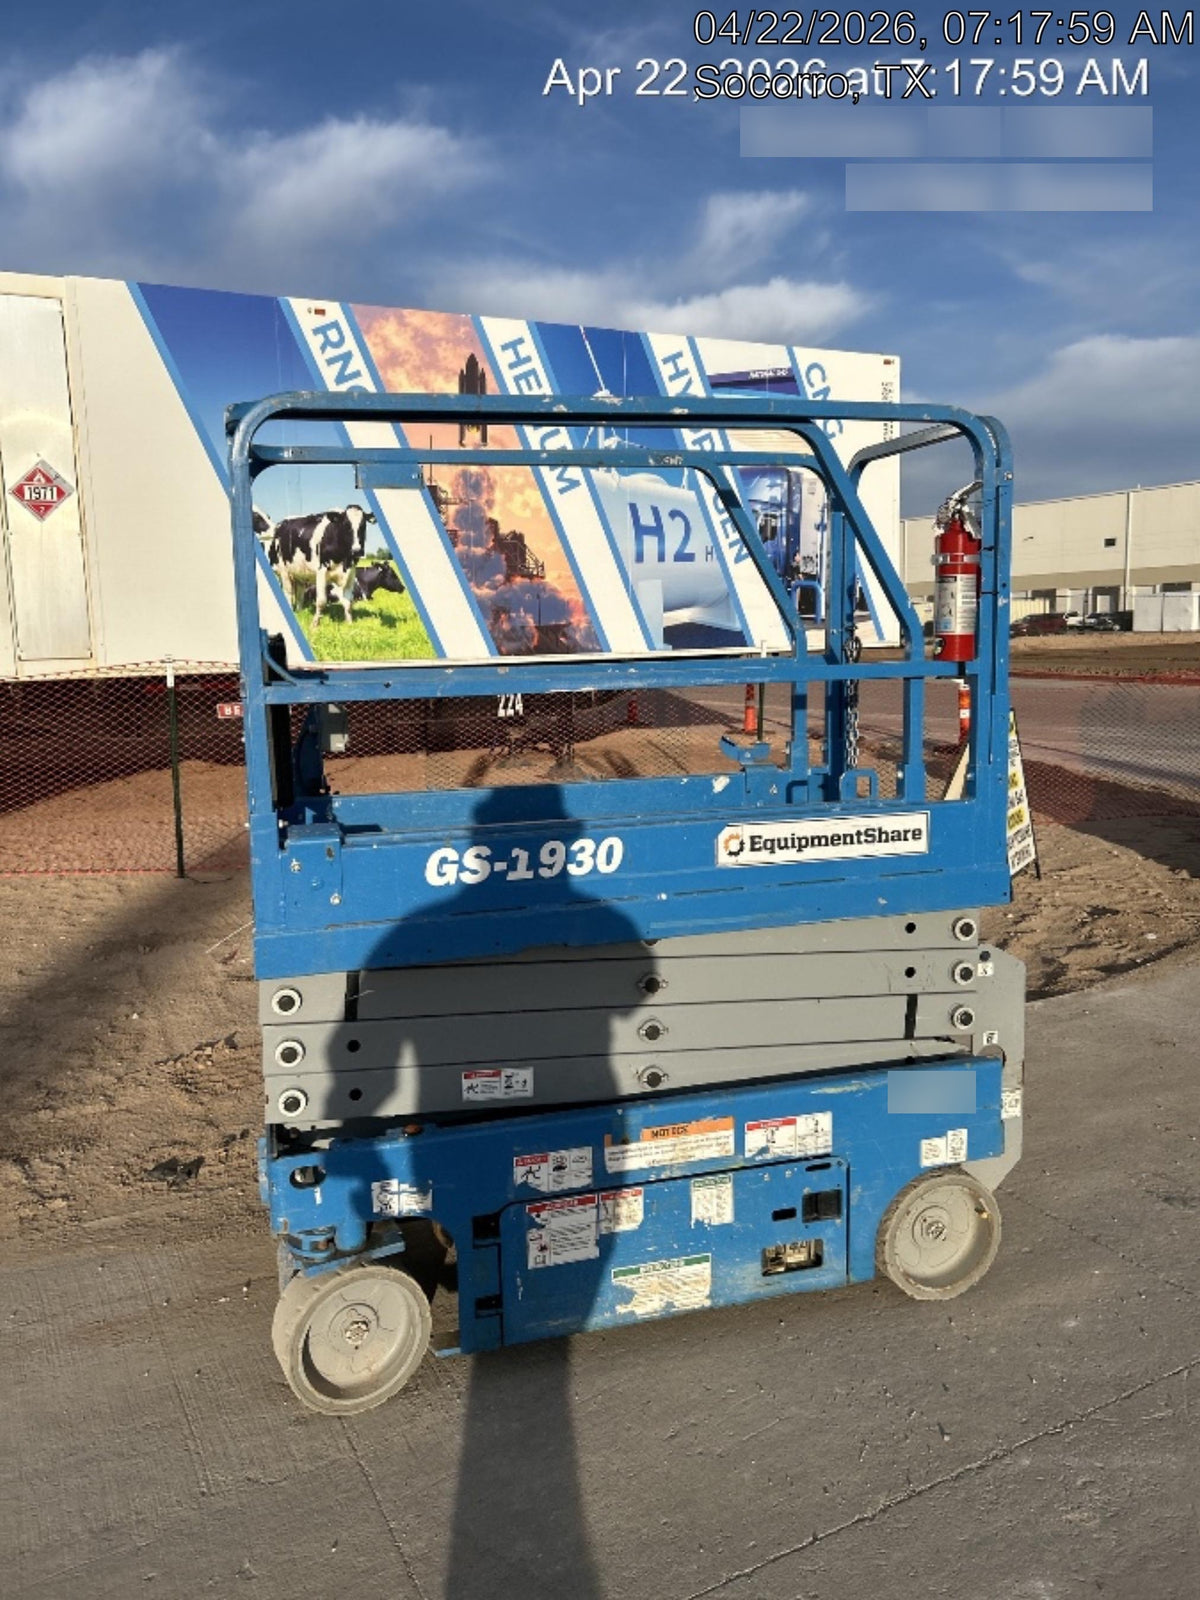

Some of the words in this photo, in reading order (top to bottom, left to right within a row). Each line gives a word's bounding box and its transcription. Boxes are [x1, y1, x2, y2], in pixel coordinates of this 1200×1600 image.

[312, 320, 369, 391] RN
[28, 486, 55, 501] 1971
[627, 503, 696, 563] H2
[424, 836, 624, 887] GS-1930
[750, 827, 923, 854] EquipmentShare
